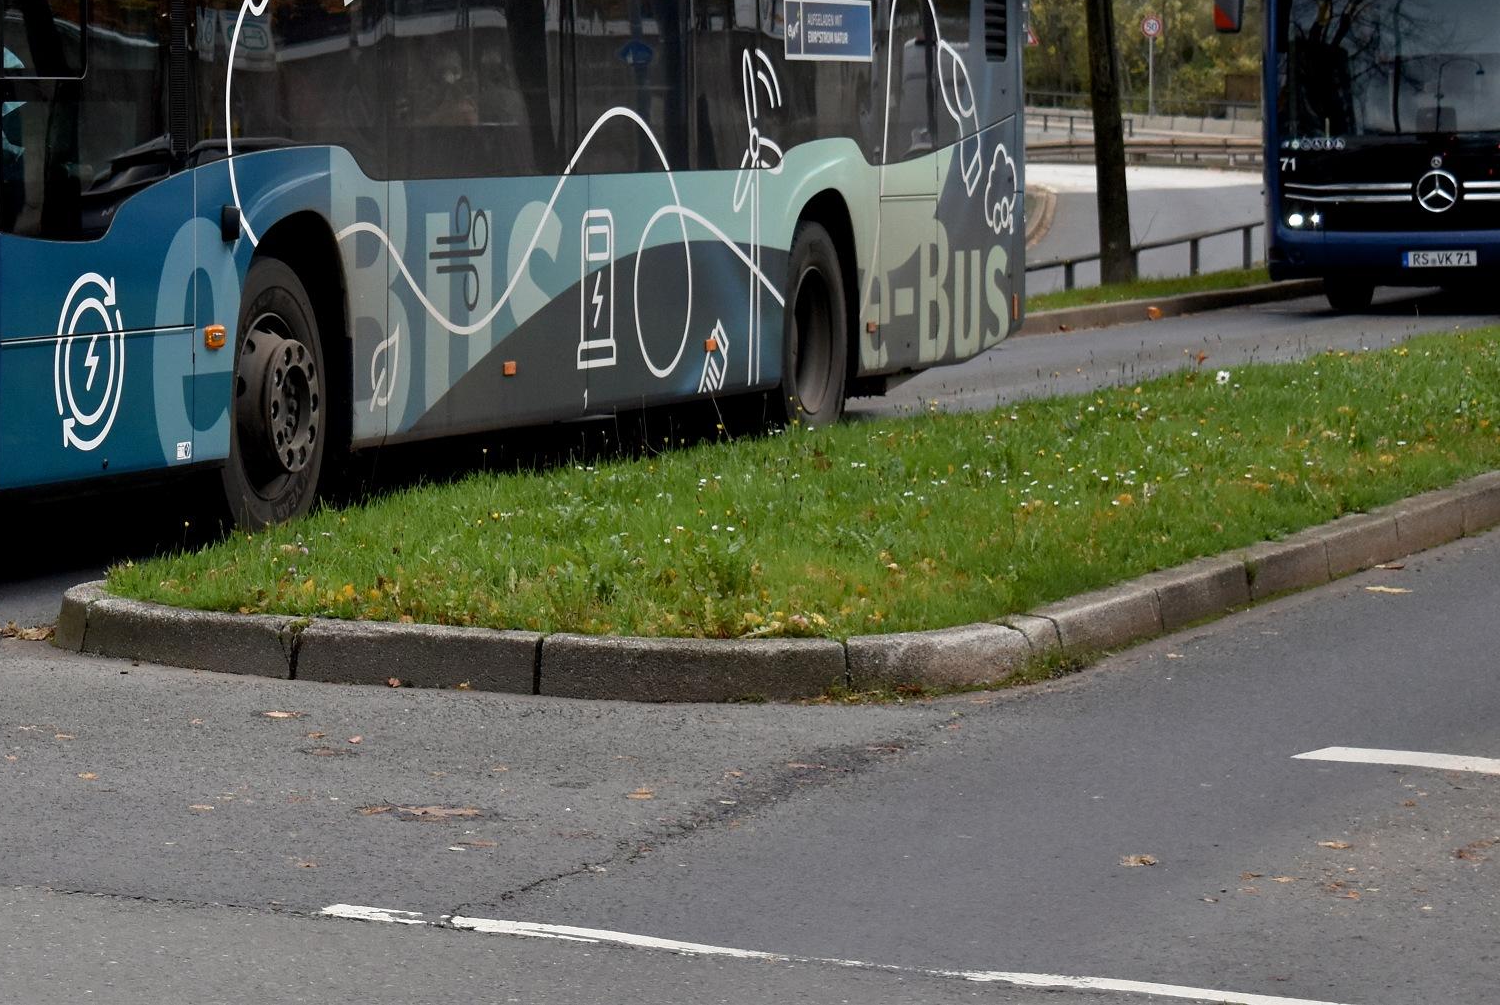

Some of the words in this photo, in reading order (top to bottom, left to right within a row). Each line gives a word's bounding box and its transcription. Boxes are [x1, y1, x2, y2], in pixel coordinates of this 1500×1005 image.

[1280, 158, 1296, 171] 71
[1413, 253, 1429, 265] RS
[1437, 252, 1453, 265] VK
[1456, 252, 1472, 265] 71
